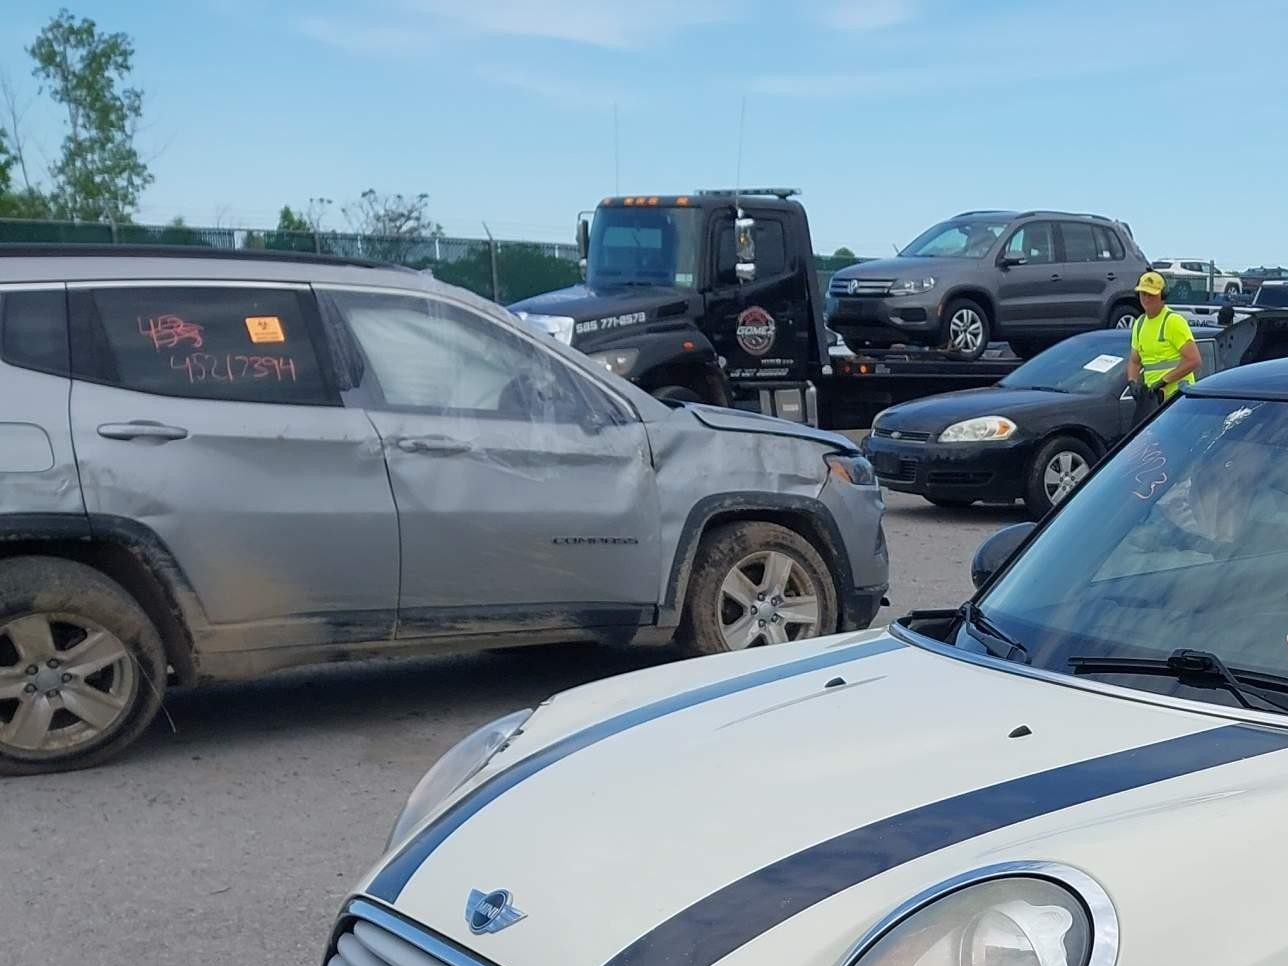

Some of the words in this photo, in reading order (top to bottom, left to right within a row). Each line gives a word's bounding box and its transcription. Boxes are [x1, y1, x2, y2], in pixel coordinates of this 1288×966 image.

[736, 321, 776, 336] GOMEZ
[170, 352, 297, 384] 45217394
[553, 537, 639, 545] COMPASS
